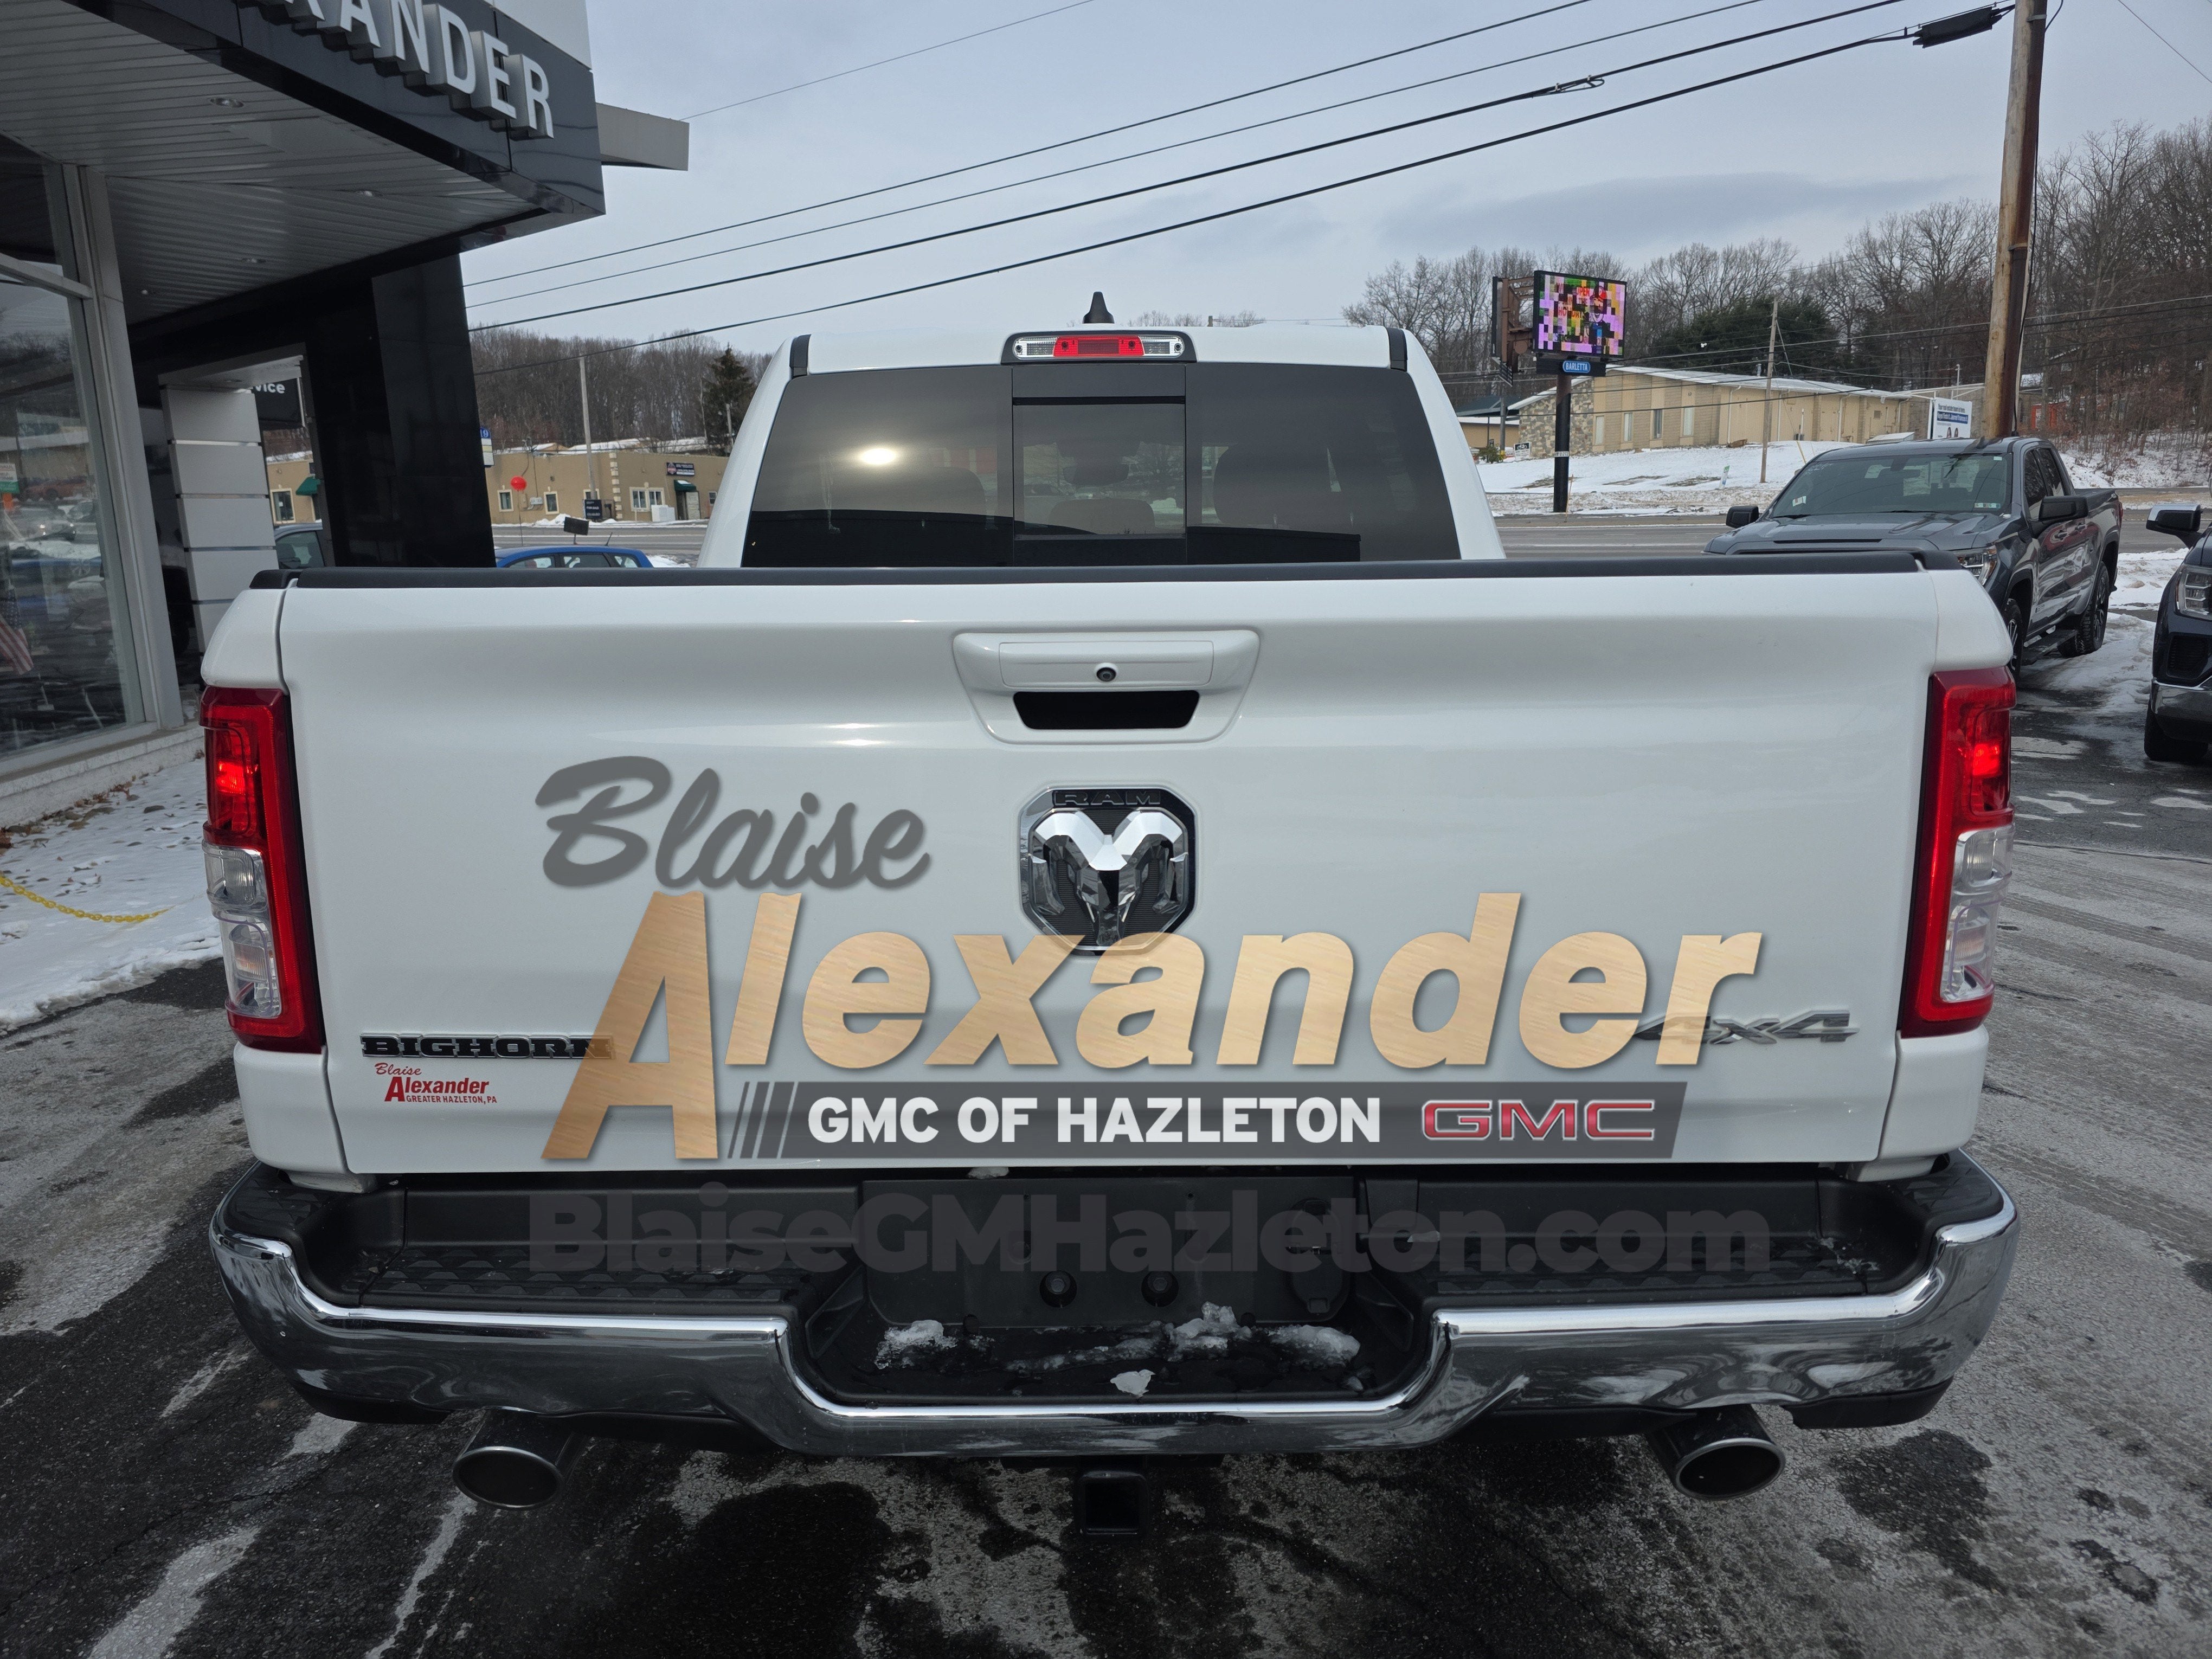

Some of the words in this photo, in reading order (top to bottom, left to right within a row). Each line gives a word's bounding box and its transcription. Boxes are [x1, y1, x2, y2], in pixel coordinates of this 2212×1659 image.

[1565, 362, 1588, 371] BARLETTA
[1053, 790, 1161, 806] RAM
[374, 1062, 422, 1076] Blaise
[384, 1076, 490, 1102] Alexander
[443, 1096, 487, 1105] HAZLETON,
